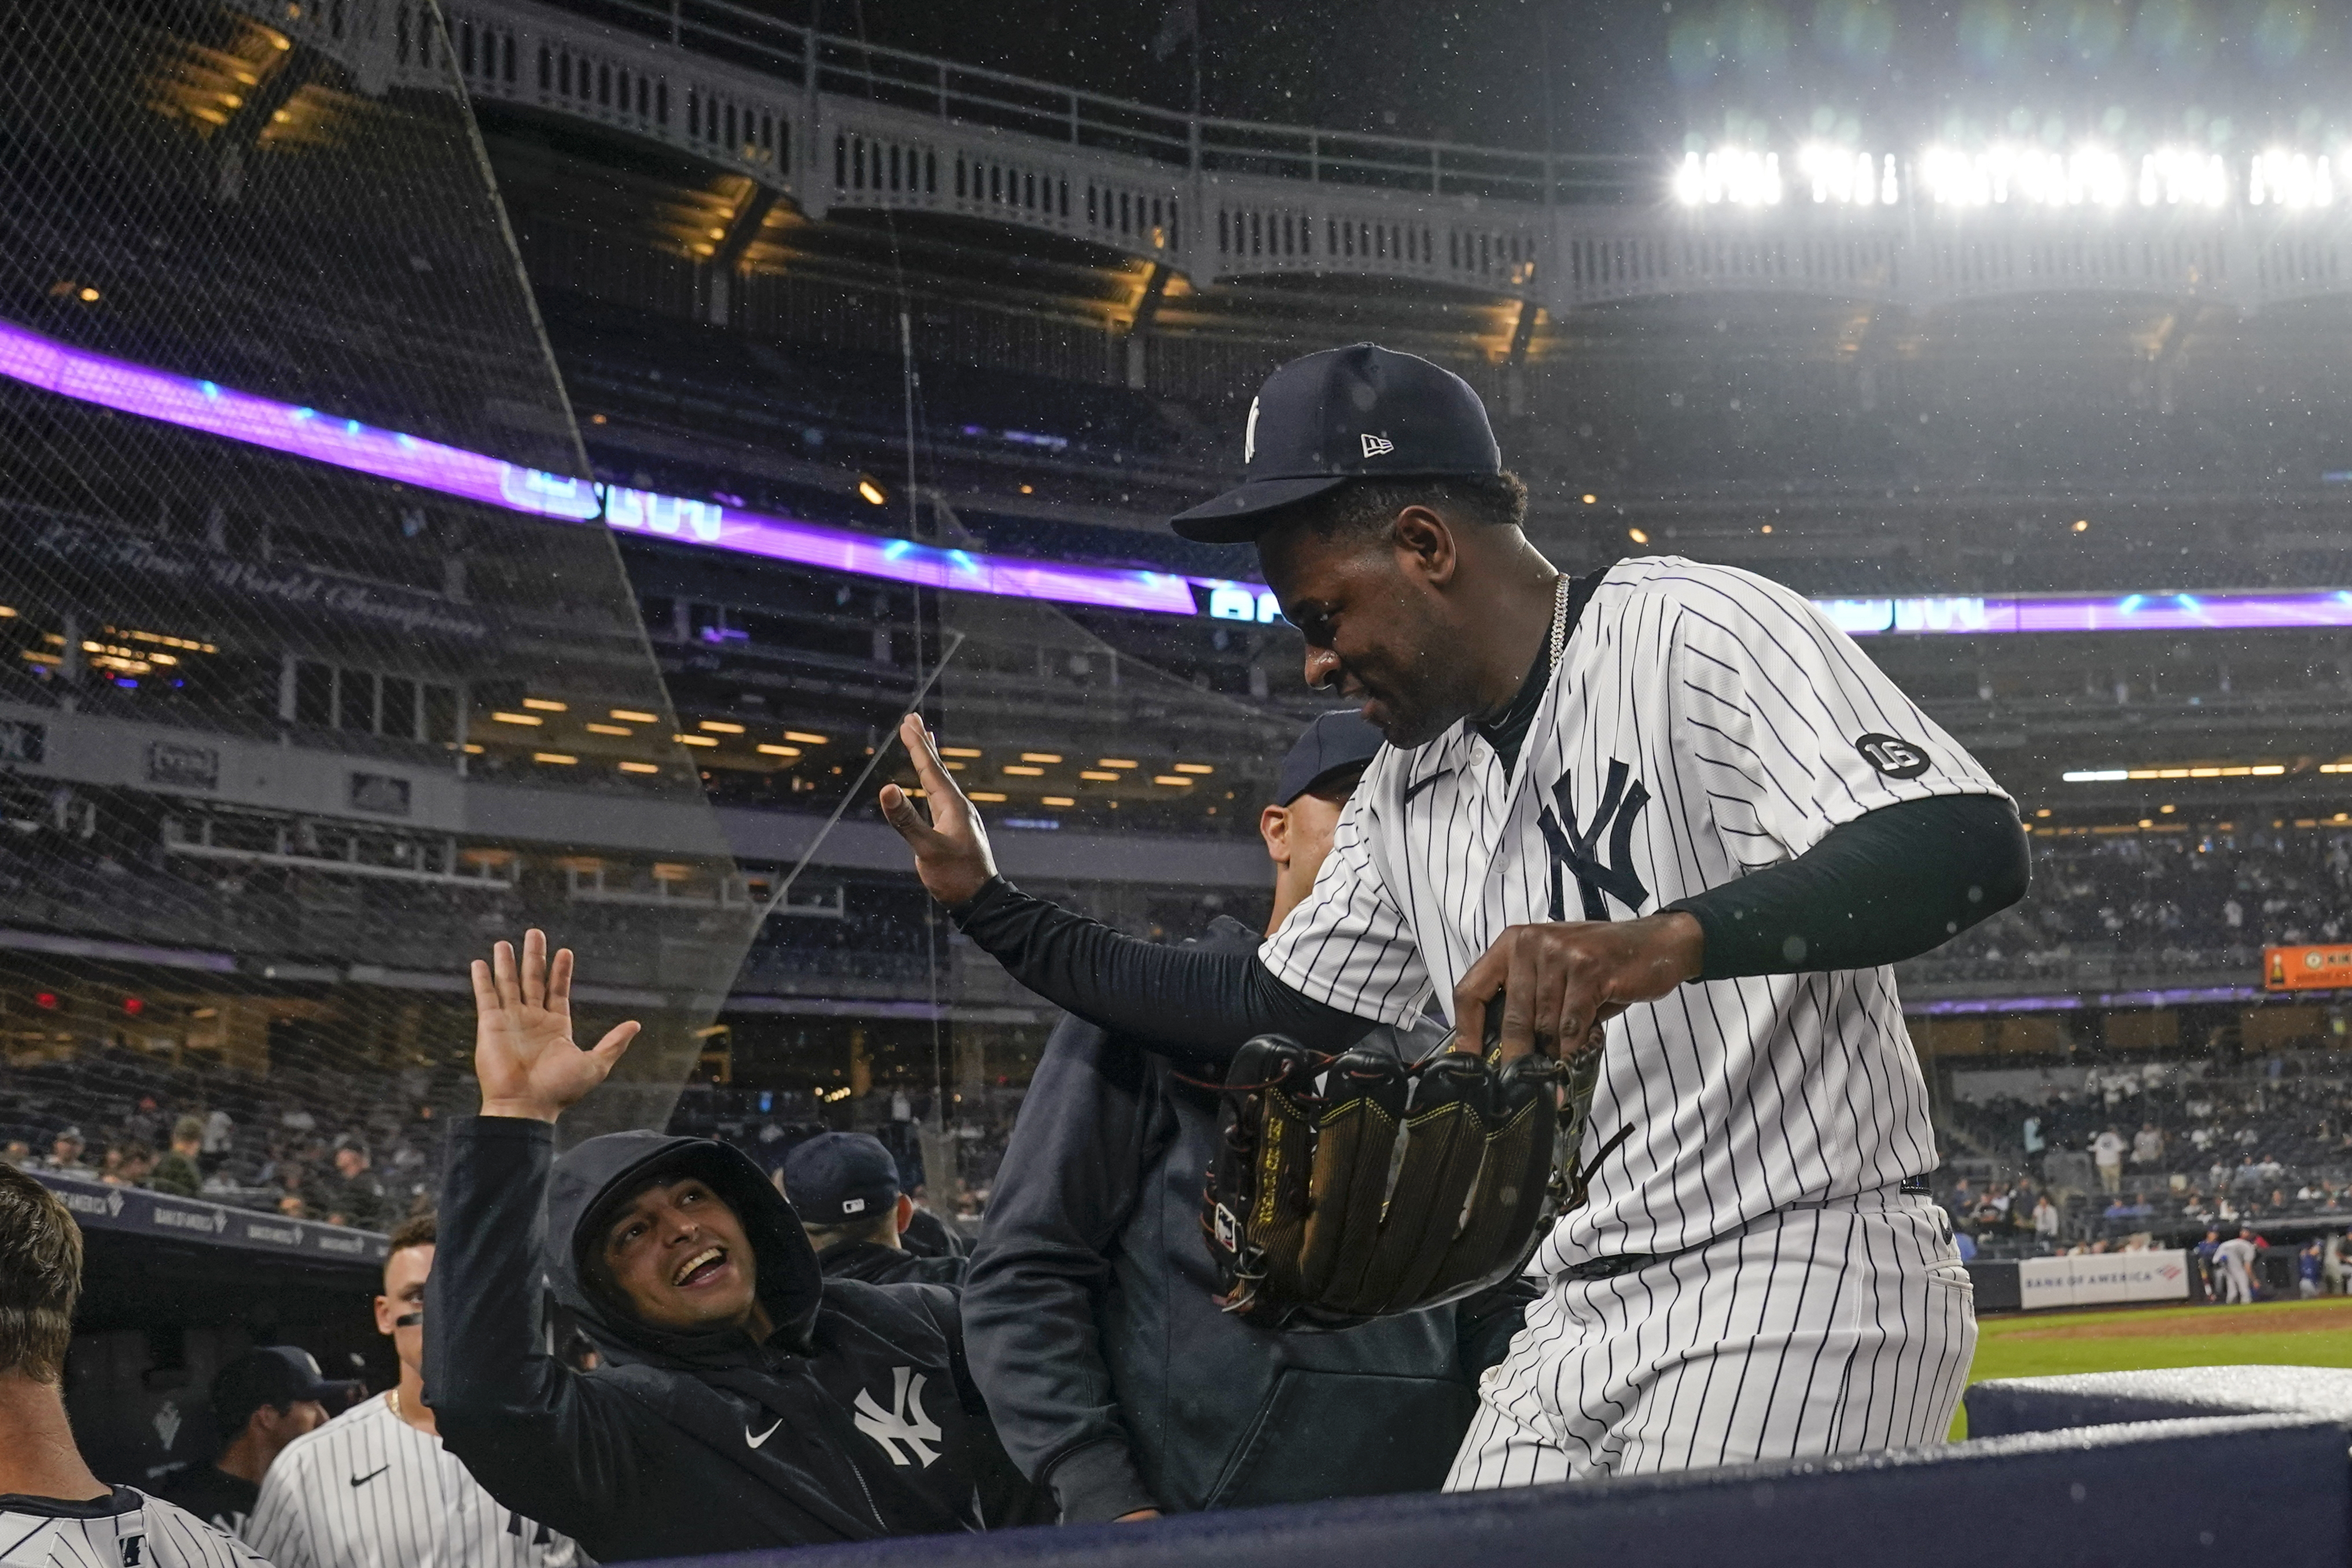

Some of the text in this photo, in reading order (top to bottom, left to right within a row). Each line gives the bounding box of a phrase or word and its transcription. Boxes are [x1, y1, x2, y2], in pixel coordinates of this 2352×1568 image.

[1864, 741, 1920, 771] 16
[1537, 757, 1651, 921] NY
[2026, 1271, 2152, 1289] BANK OF AMERICA
[854, 1366, 942, 1468] NY
